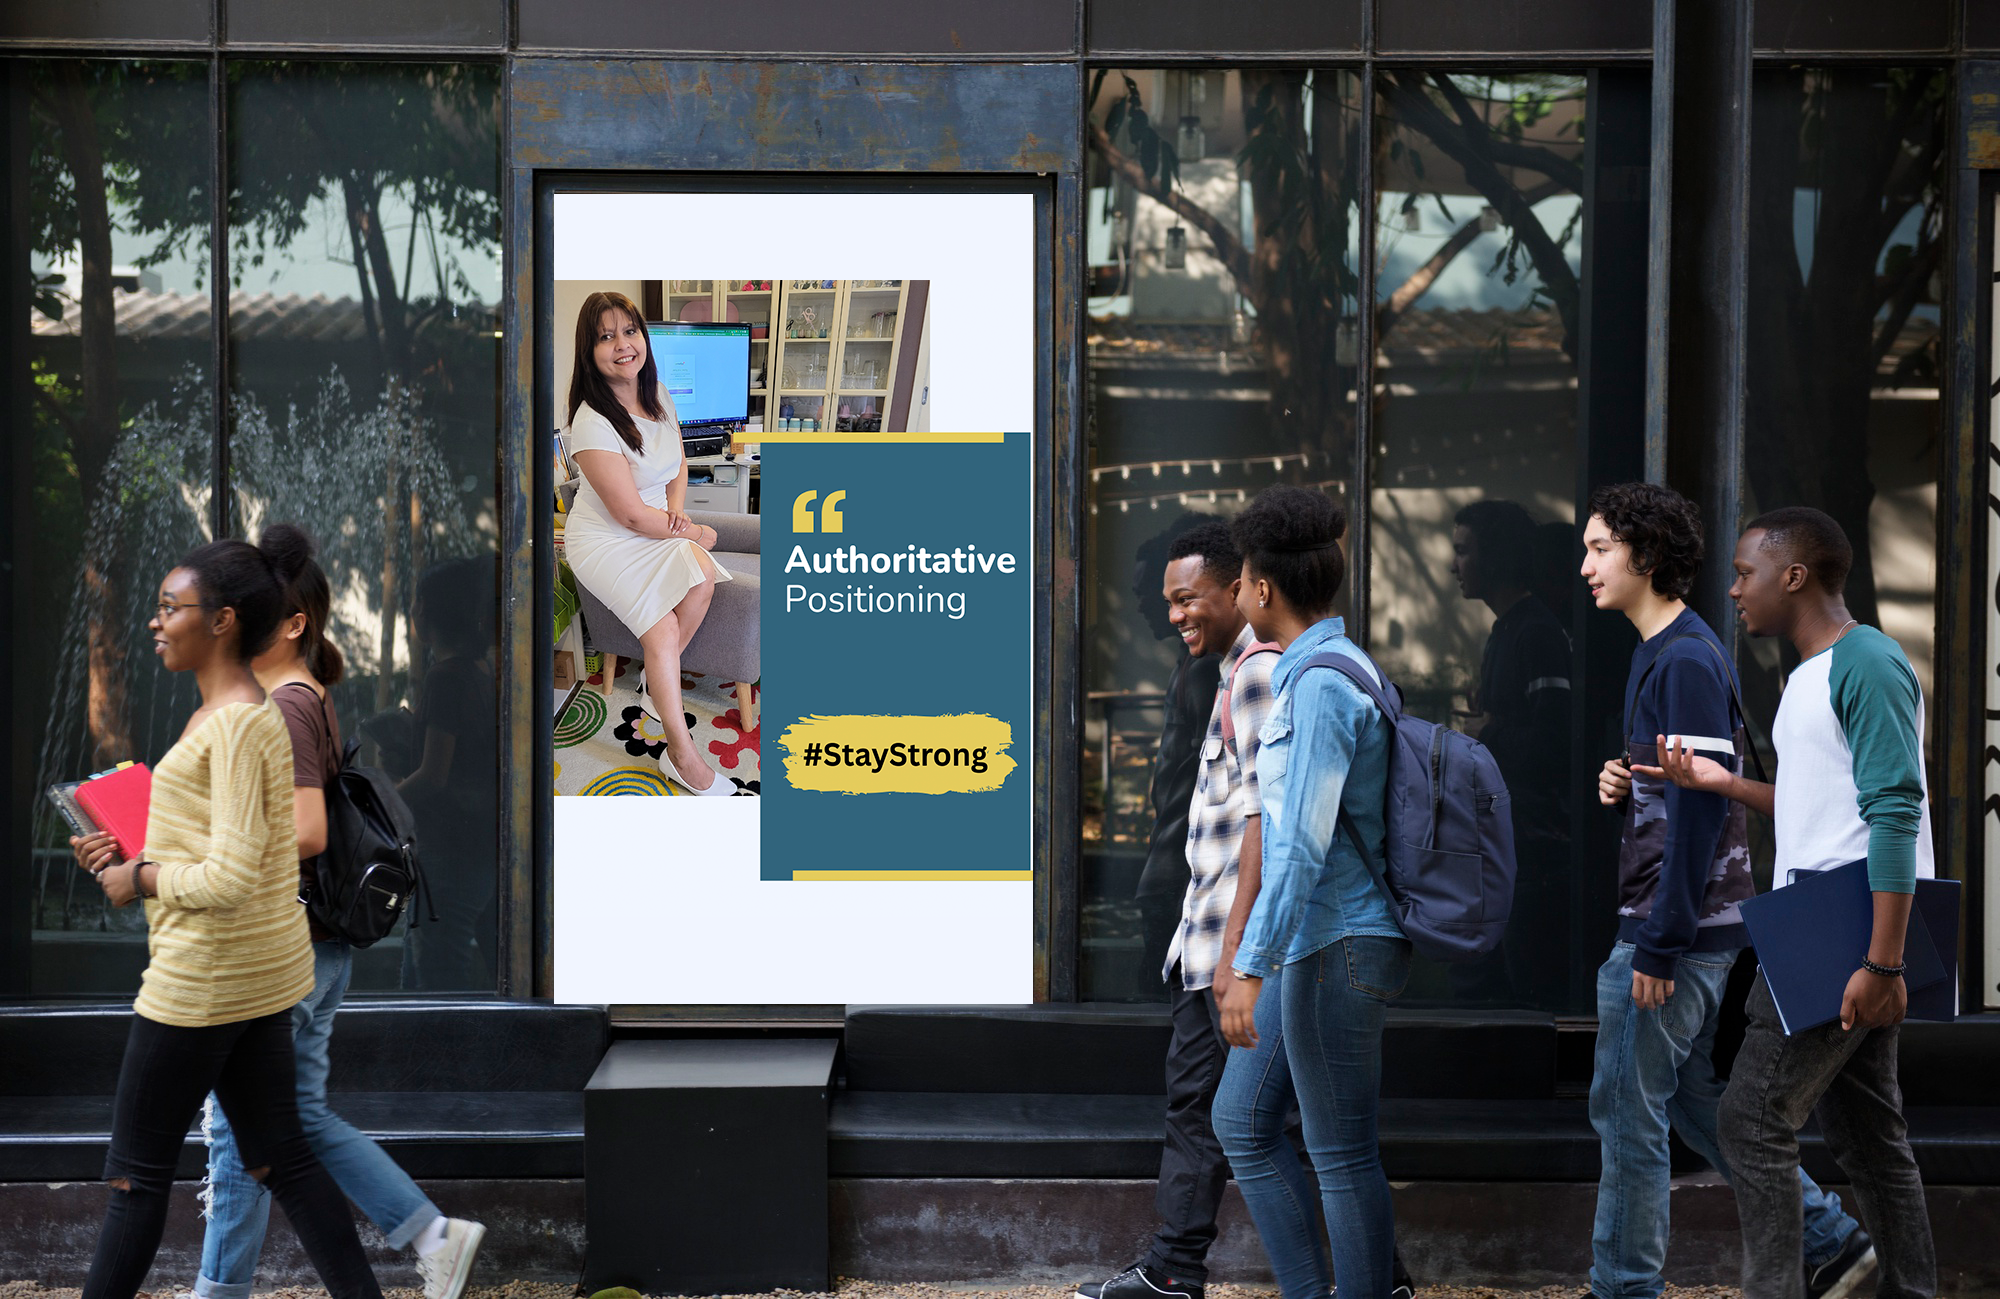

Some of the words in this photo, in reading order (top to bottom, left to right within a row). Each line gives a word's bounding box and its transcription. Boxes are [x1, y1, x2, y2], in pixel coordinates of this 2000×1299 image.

[785, 544, 1016, 573] Authoritative
[786, 585, 966, 619] Positioning
[803, 743, 988, 773] #StayStrong
